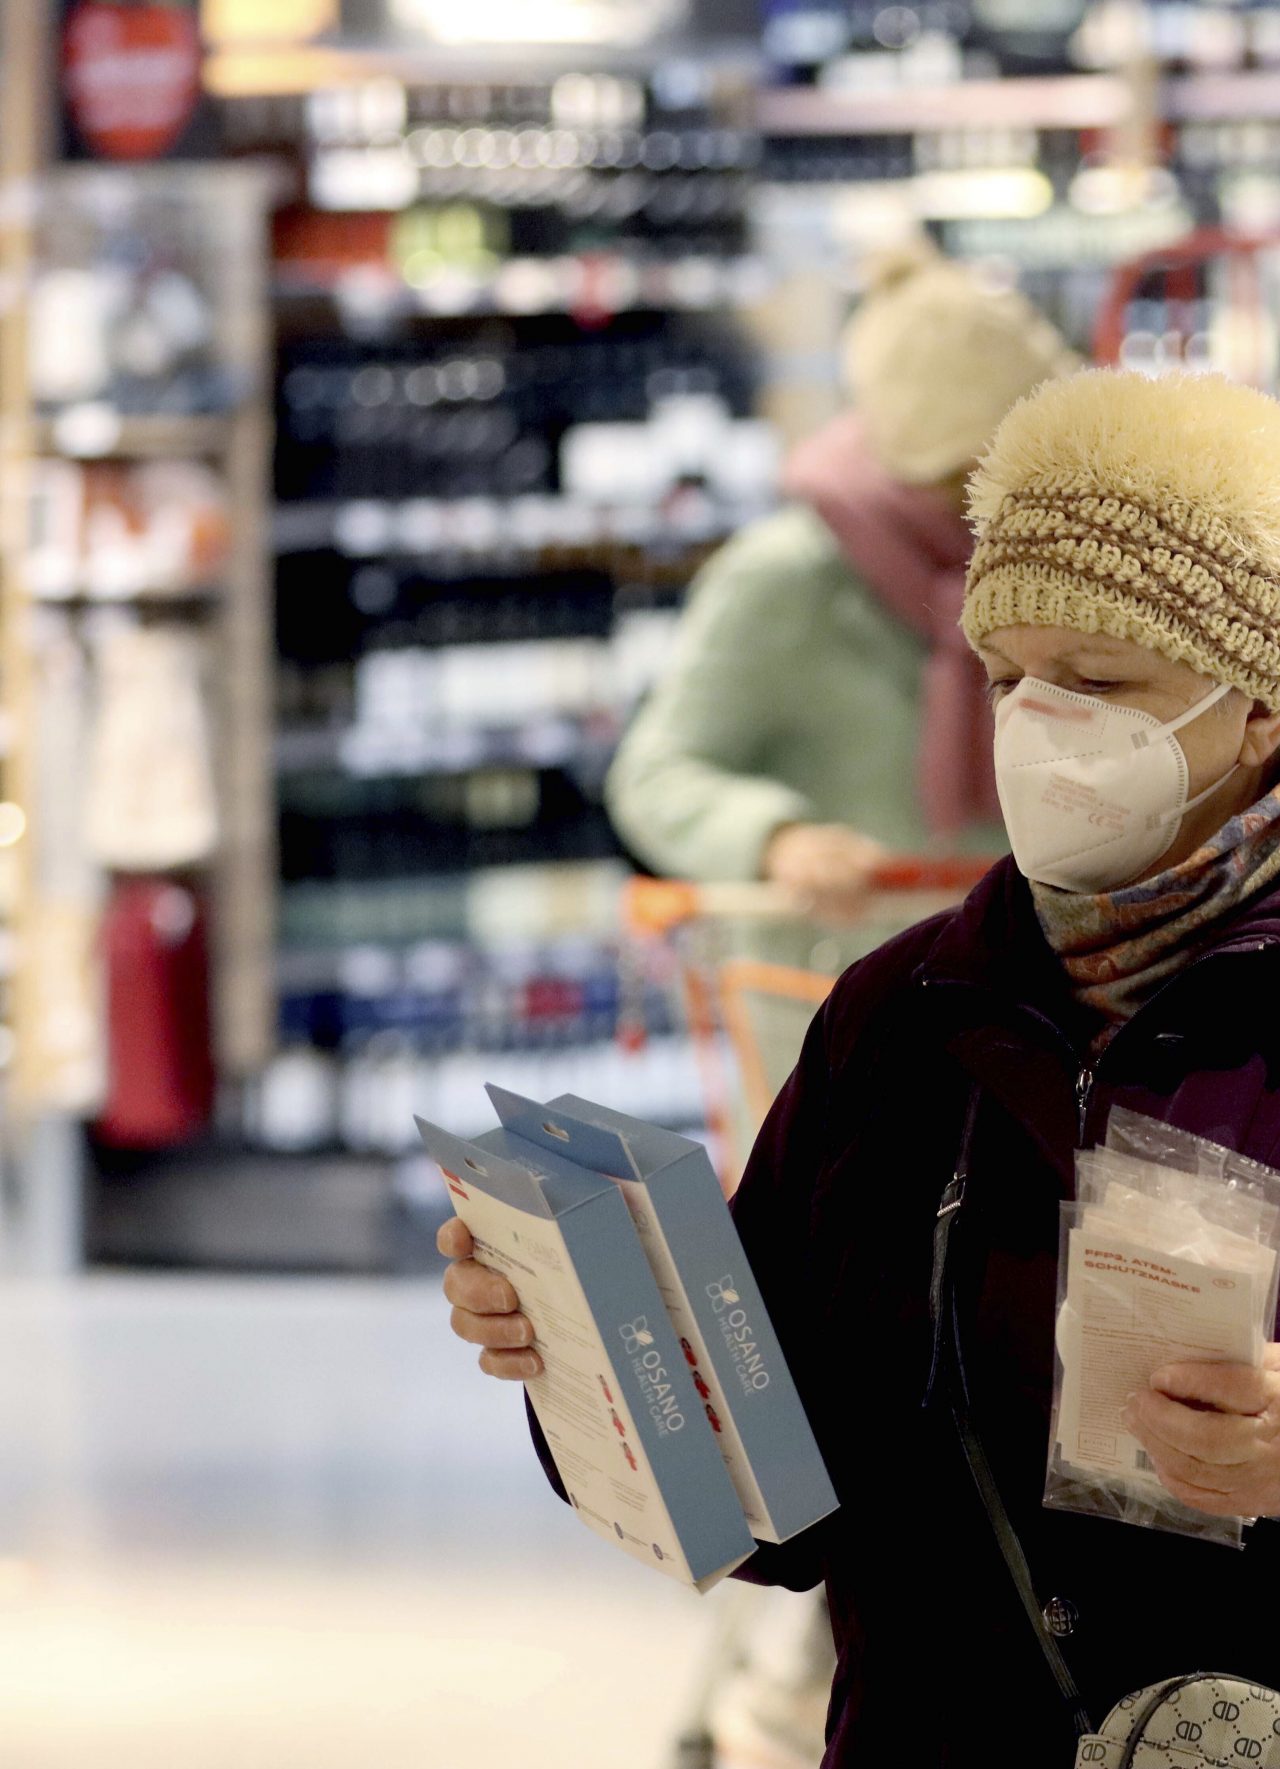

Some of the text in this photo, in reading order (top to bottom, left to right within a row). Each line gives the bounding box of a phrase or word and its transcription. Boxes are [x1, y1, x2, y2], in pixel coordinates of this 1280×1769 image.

[1084, 1260, 1201, 1293] SCHUTZMASKE
[718, 1316, 754, 1396] HEALTH CARE
[728, 1309, 770, 1389] OSANO
[632, 1356, 669, 1439] HEALTH CARE
[642, 1350, 685, 1431] OSANO
